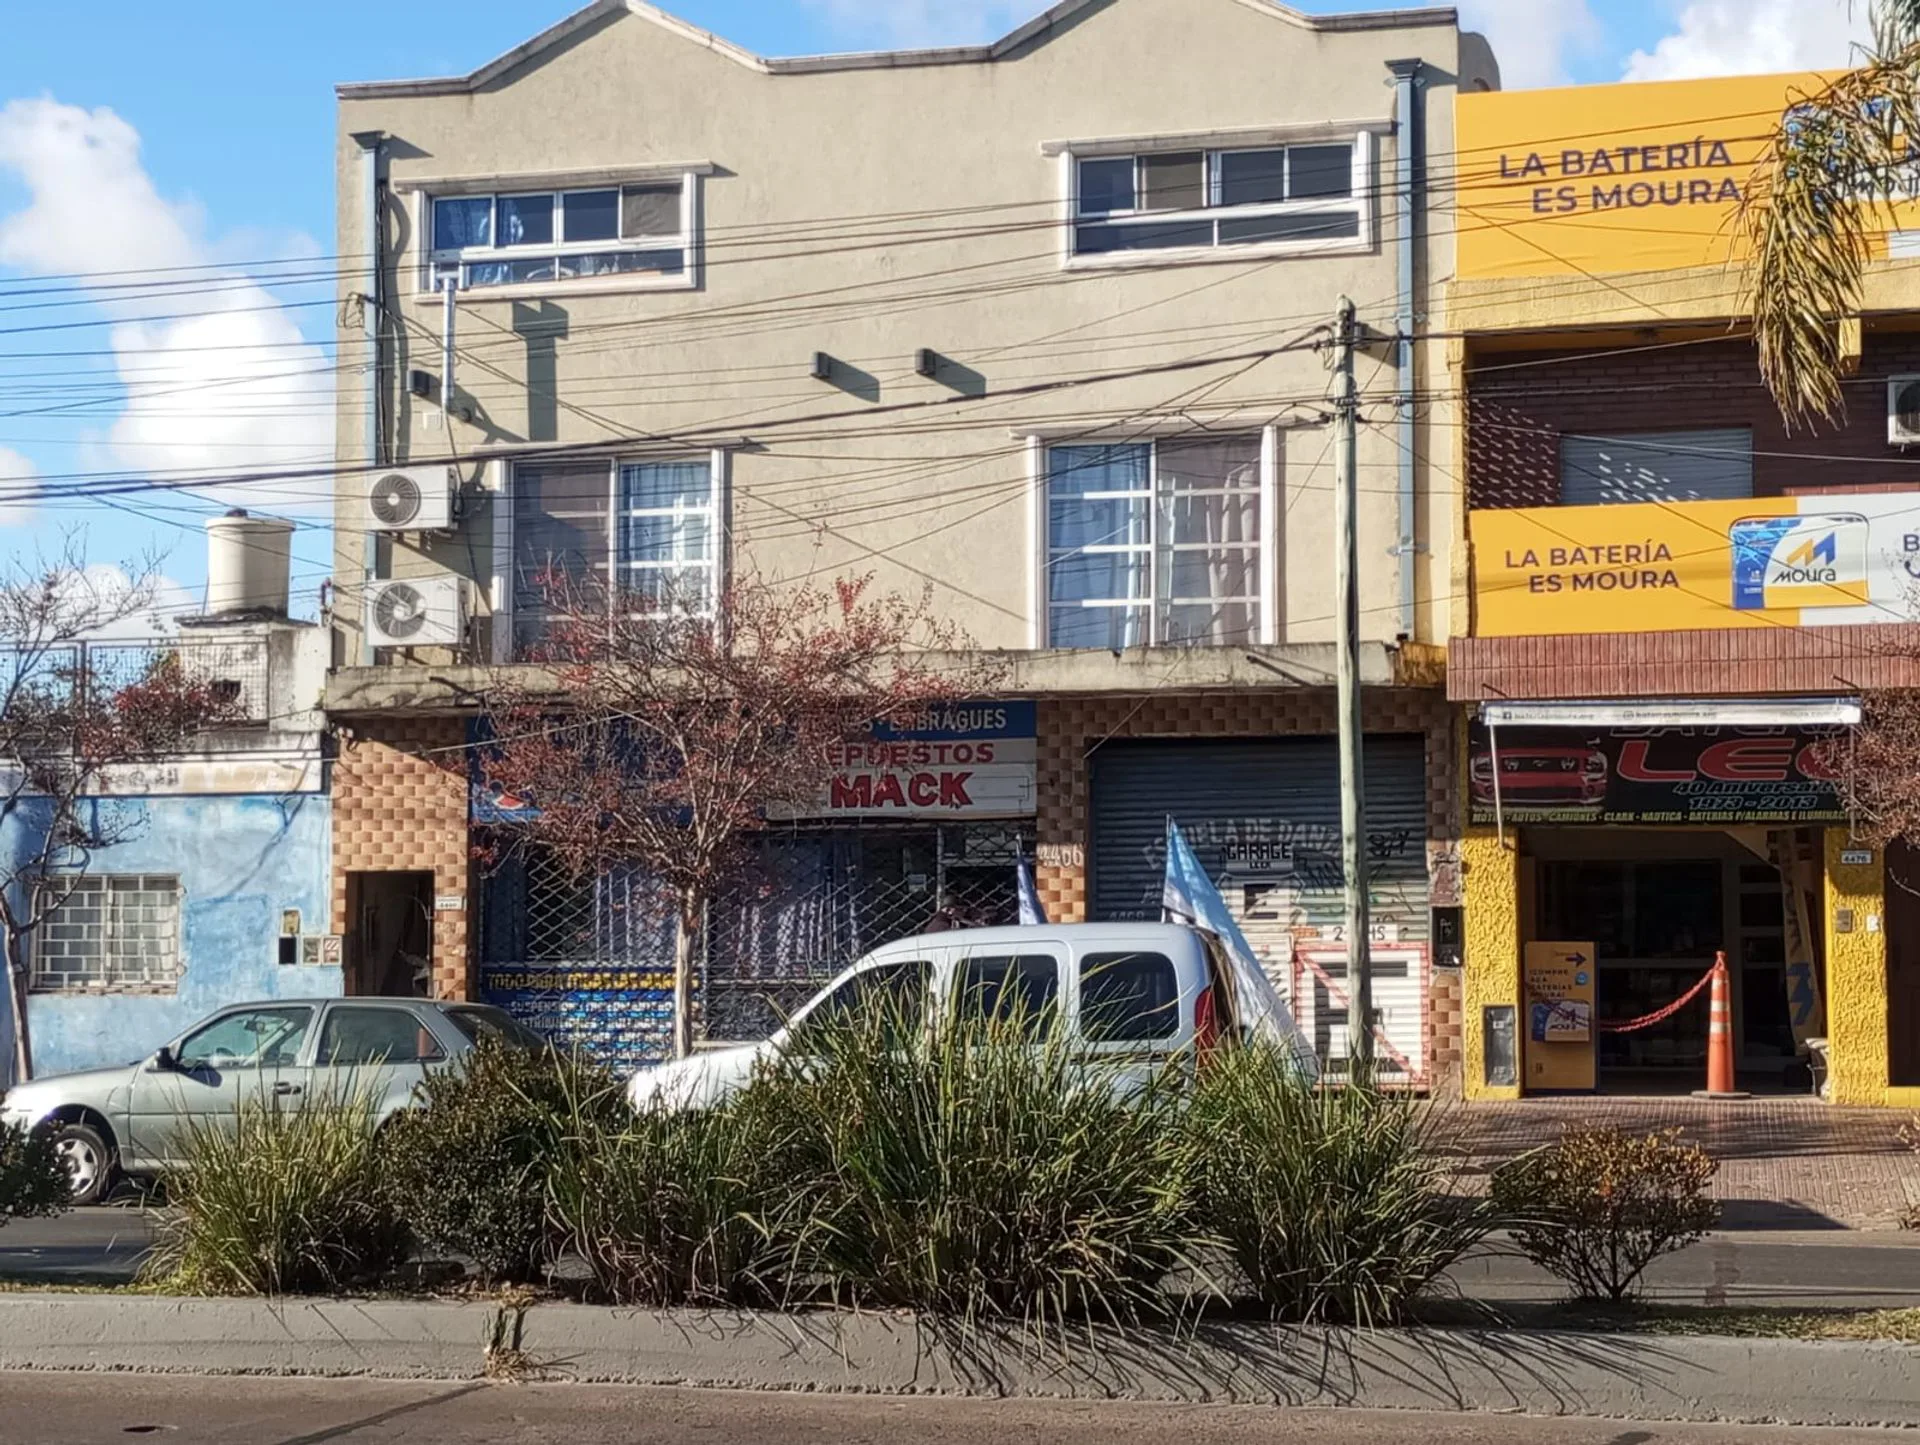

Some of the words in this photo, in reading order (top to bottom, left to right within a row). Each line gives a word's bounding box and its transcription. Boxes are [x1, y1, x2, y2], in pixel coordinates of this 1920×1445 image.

[1499, 151, 1547, 179] LA
[1561, 136, 1733, 176] BATERÍA
[1532, 186, 1577, 213] ES
[1591, 177, 1742, 210] MOURA
[1505, 547, 1539, 568] LA
[1549, 539, 1672, 566] BATERÍA
[1529, 573, 1563, 594] ES
[1573, 568, 1680, 591] MOURA
[829, 743, 995, 767] EPUESTOS
[830, 771, 975, 809] MACK
[1706, 780, 1838, 795] Aniversari
[1689, 796, 1744, 810] 1973
[1758, 795, 1818, 810] 2013
[1227, 843, 1292, 860] GARAGE
